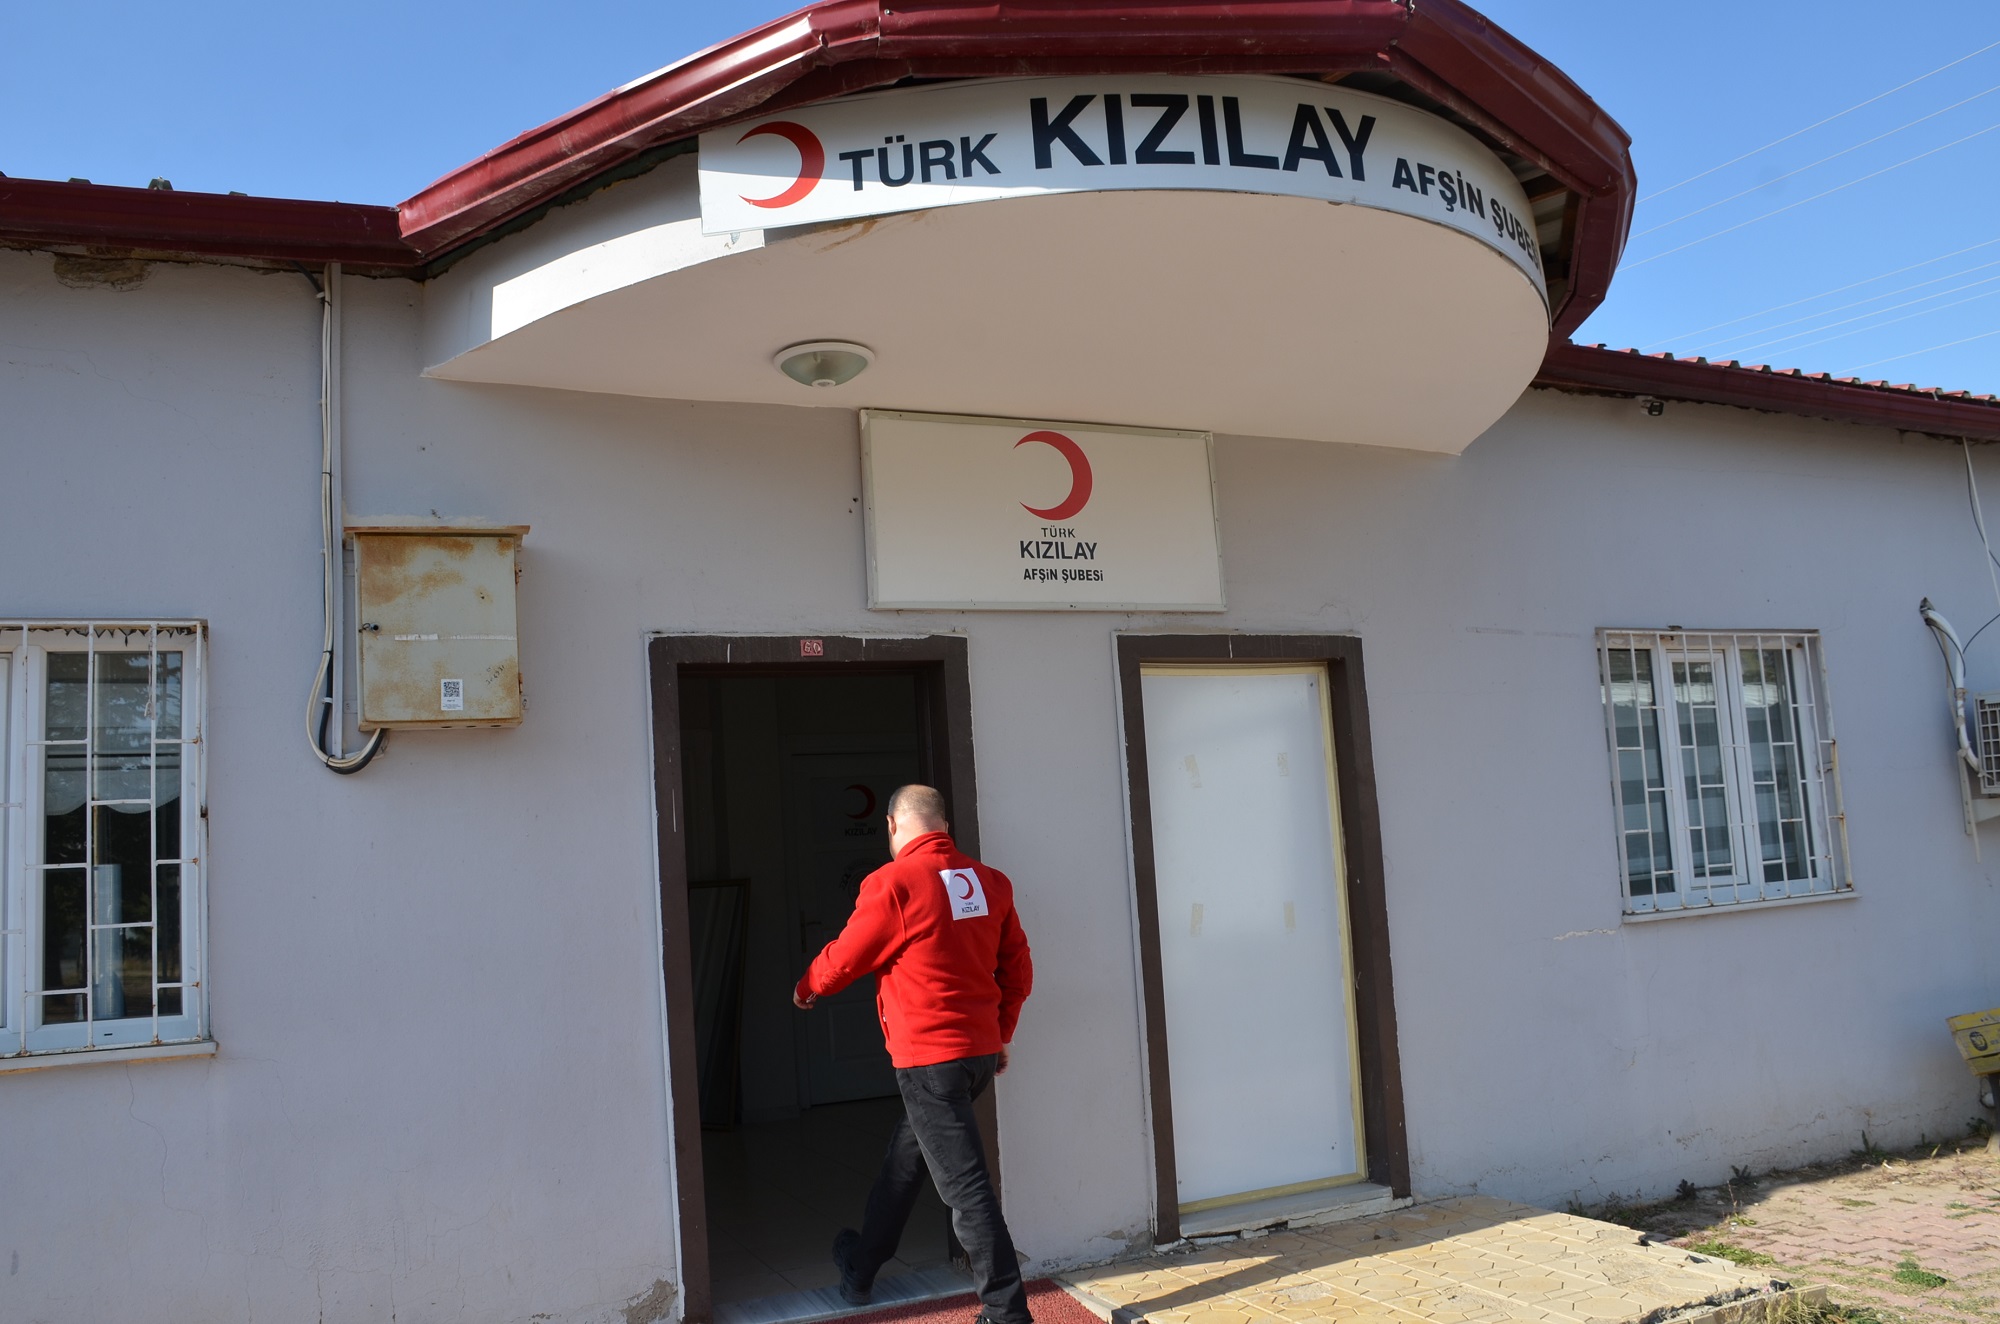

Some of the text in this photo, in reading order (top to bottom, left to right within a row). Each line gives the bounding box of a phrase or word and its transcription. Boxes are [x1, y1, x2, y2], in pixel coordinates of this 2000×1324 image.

[839, 132, 1001, 191] TÜRK
[1029, 93, 1376, 181] KIZILAY
[1392, 157, 1485, 218] AFŞİN
[1041, 525, 1076, 538] TÜRK
[1020, 540, 1097, 560] KIZILAY
[844, 827, 877, 837] KIZILAY
